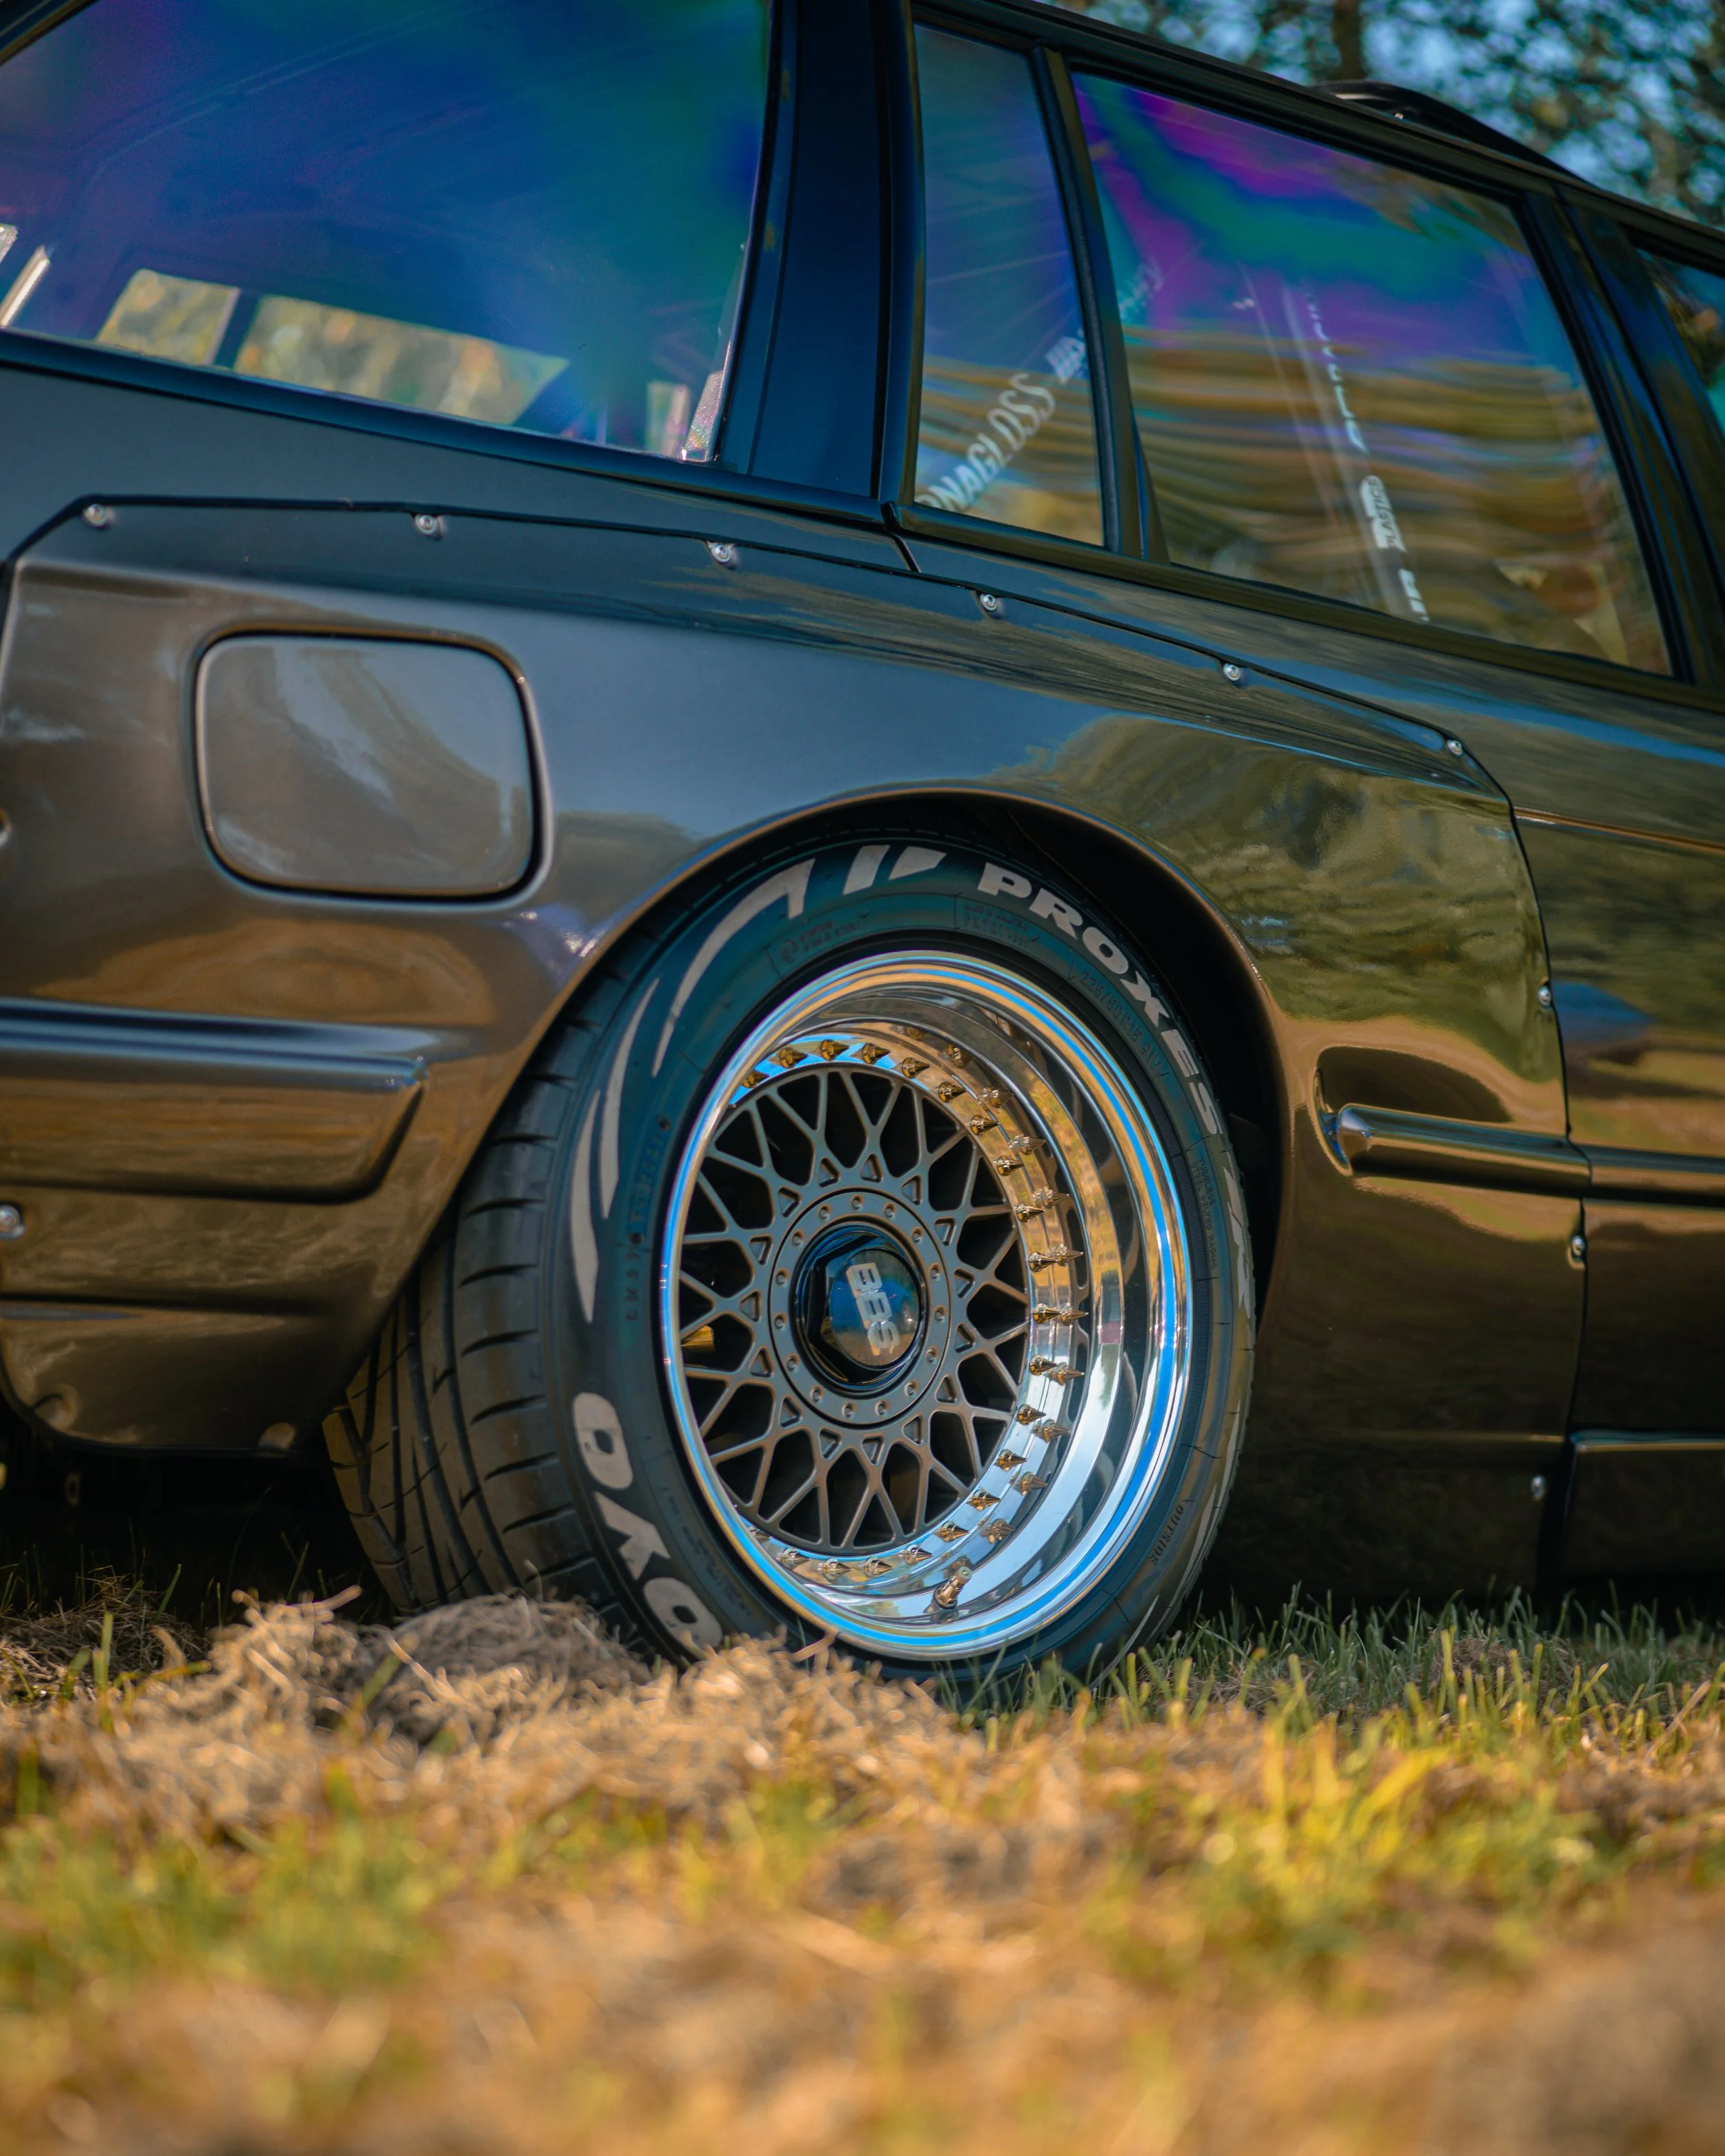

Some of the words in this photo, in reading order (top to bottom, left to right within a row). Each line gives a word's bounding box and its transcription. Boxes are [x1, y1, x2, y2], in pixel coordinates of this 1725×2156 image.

[977, 862, 1224, 1135] PROXES
[1198, 1158, 1216, 1206] TUBELESS
[847, 1262, 900, 1356] BBS
[1148, 1505, 1183, 1565] OUTSIDE
